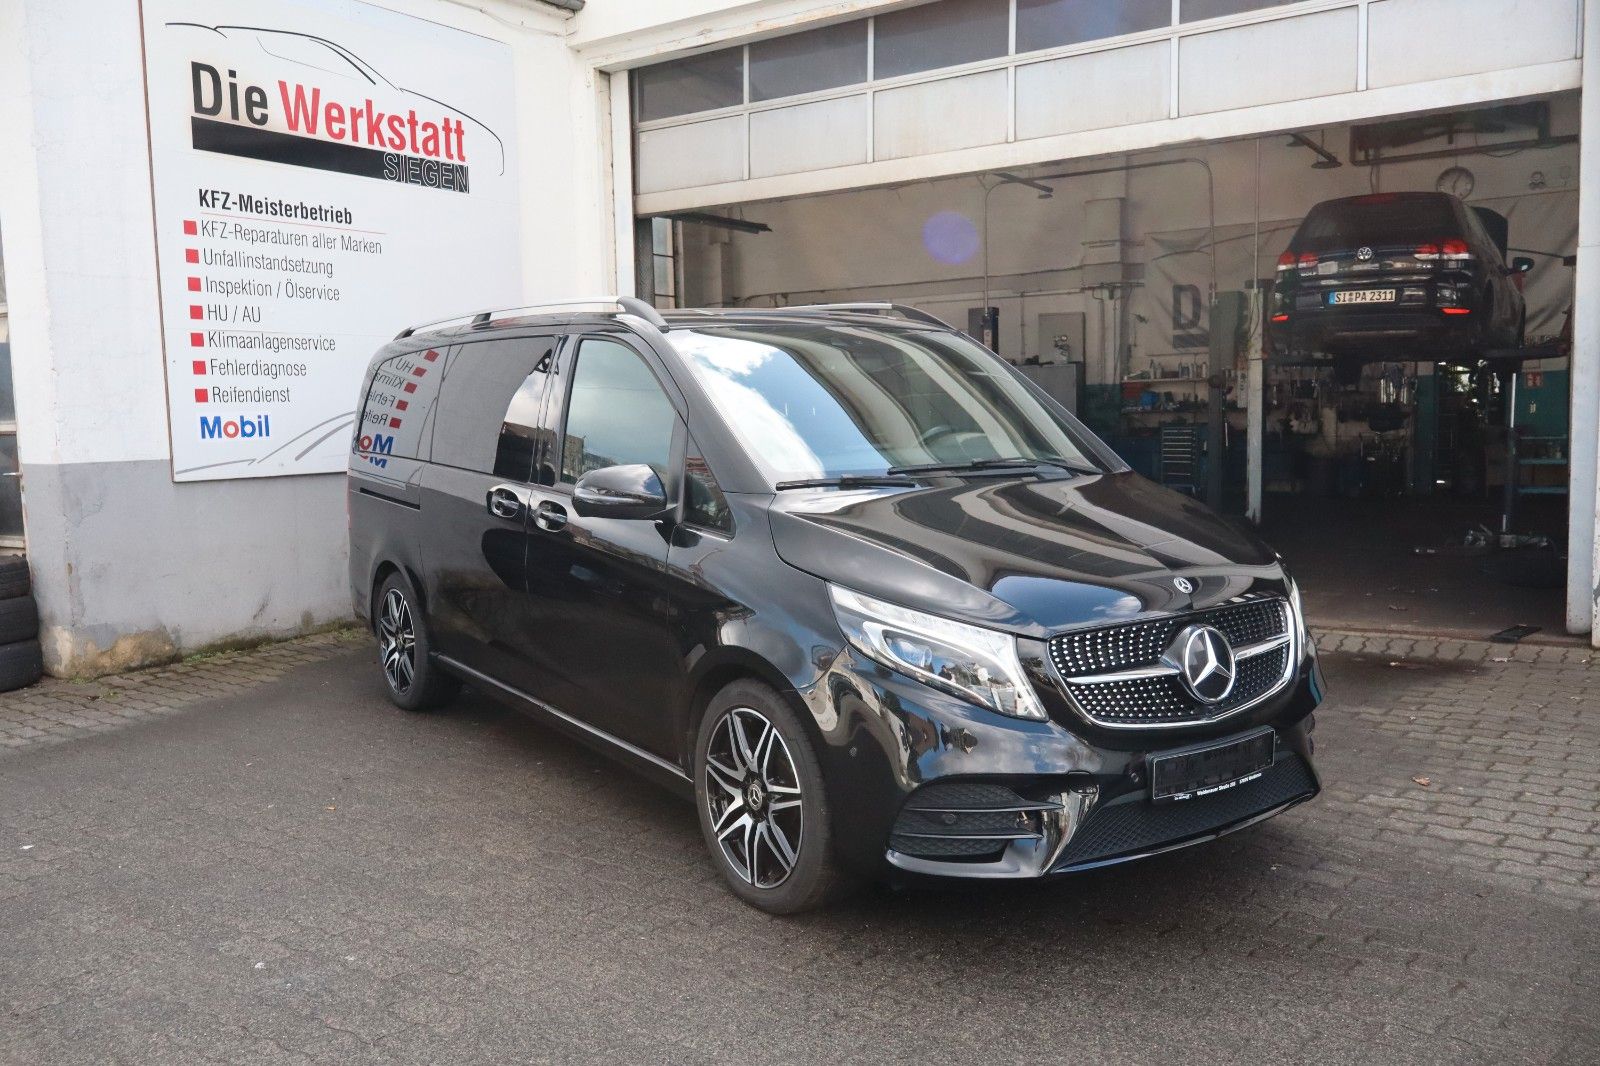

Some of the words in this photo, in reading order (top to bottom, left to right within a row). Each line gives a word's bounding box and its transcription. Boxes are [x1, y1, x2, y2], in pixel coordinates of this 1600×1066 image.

[191, 61, 268, 126] Die
[278, 80, 466, 162] Werkstatt
[384, 152, 469, 194] SIEGEN
[198, 188, 353, 225] KFZ-Meisterbetrieb
[201, 220, 308, 246] KFZ-Reparaturen
[312, 232, 337, 249] aller
[341, 235, 382, 254] Marken
[203, 248, 333, 278] Unfallinstandsetzung
[205, 276, 272, 297] Inspektion
[276, 282, 282, 298] /
[285, 279, 340, 301] Ölservice
[1335, 292, 1347, 303] SI
[1354, 291, 1367, 302] PA
[1369, 290, 1394, 301] 2311
[207, 304, 228, 322] HU
[232, 305, 238, 323] /
[242, 305, 261, 323] AU
[208, 331, 336, 352] Klimaanlagenservice
[210, 359, 307, 379] Fehlerdiagnose
[212, 386, 291, 403] Reifendienst
[200, 415, 270, 439] Mobil
